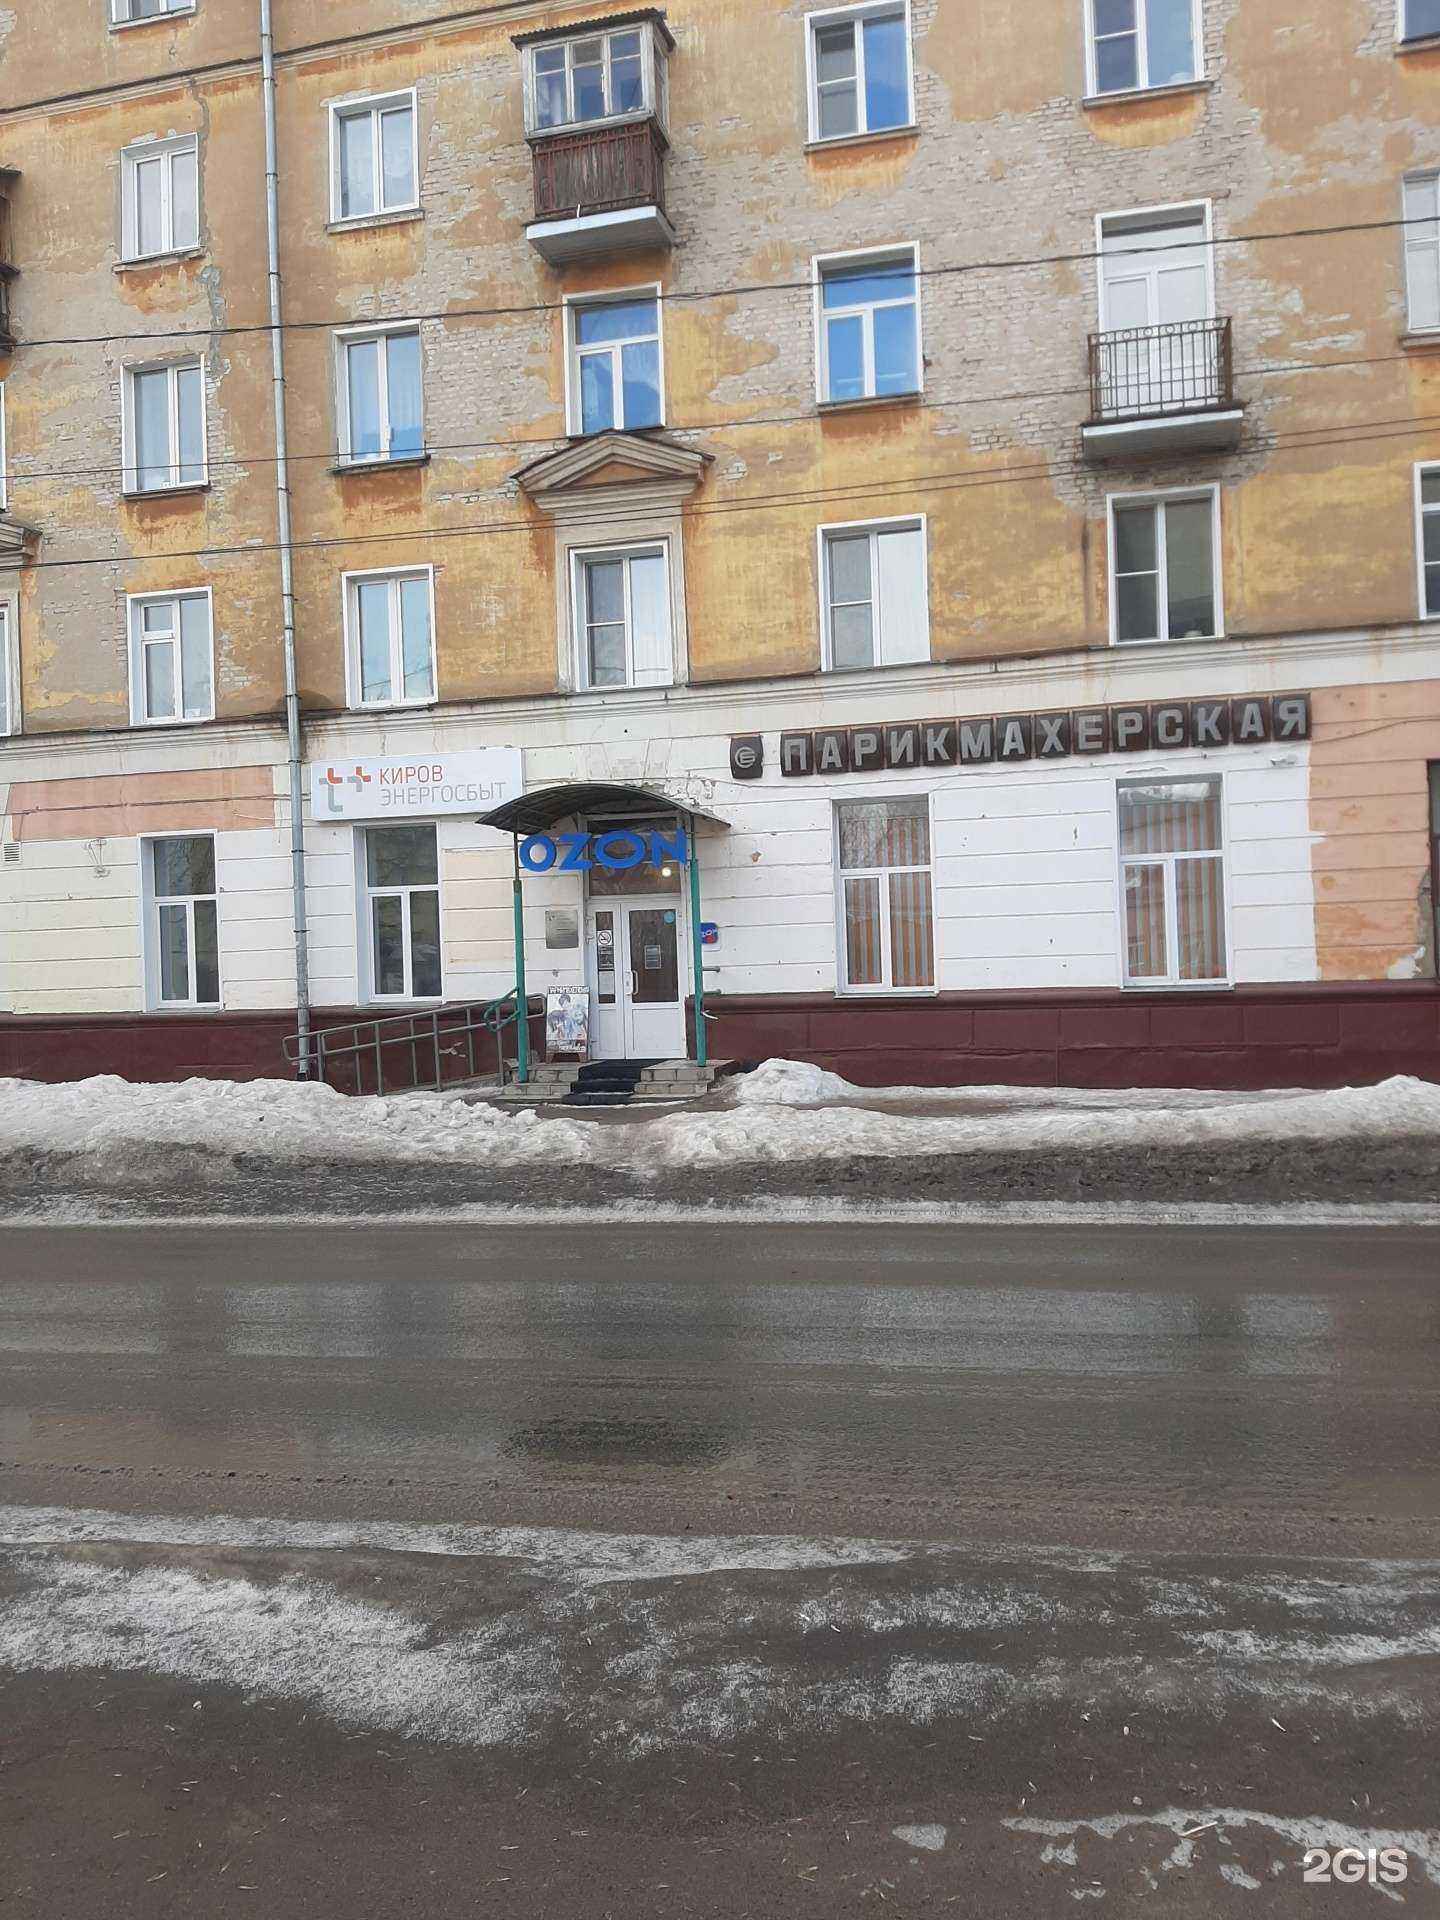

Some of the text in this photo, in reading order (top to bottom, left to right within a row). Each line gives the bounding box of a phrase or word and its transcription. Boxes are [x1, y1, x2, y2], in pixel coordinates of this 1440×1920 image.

[784, 700, 1306, 772] ПАРИКМАХЕРСКАЯ
[379, 765, 443, 785] КИРОВ
[380, 782, 506, 806] ЭНЕРГОСБЫТ
[519, 827, 688, 872] OZON
